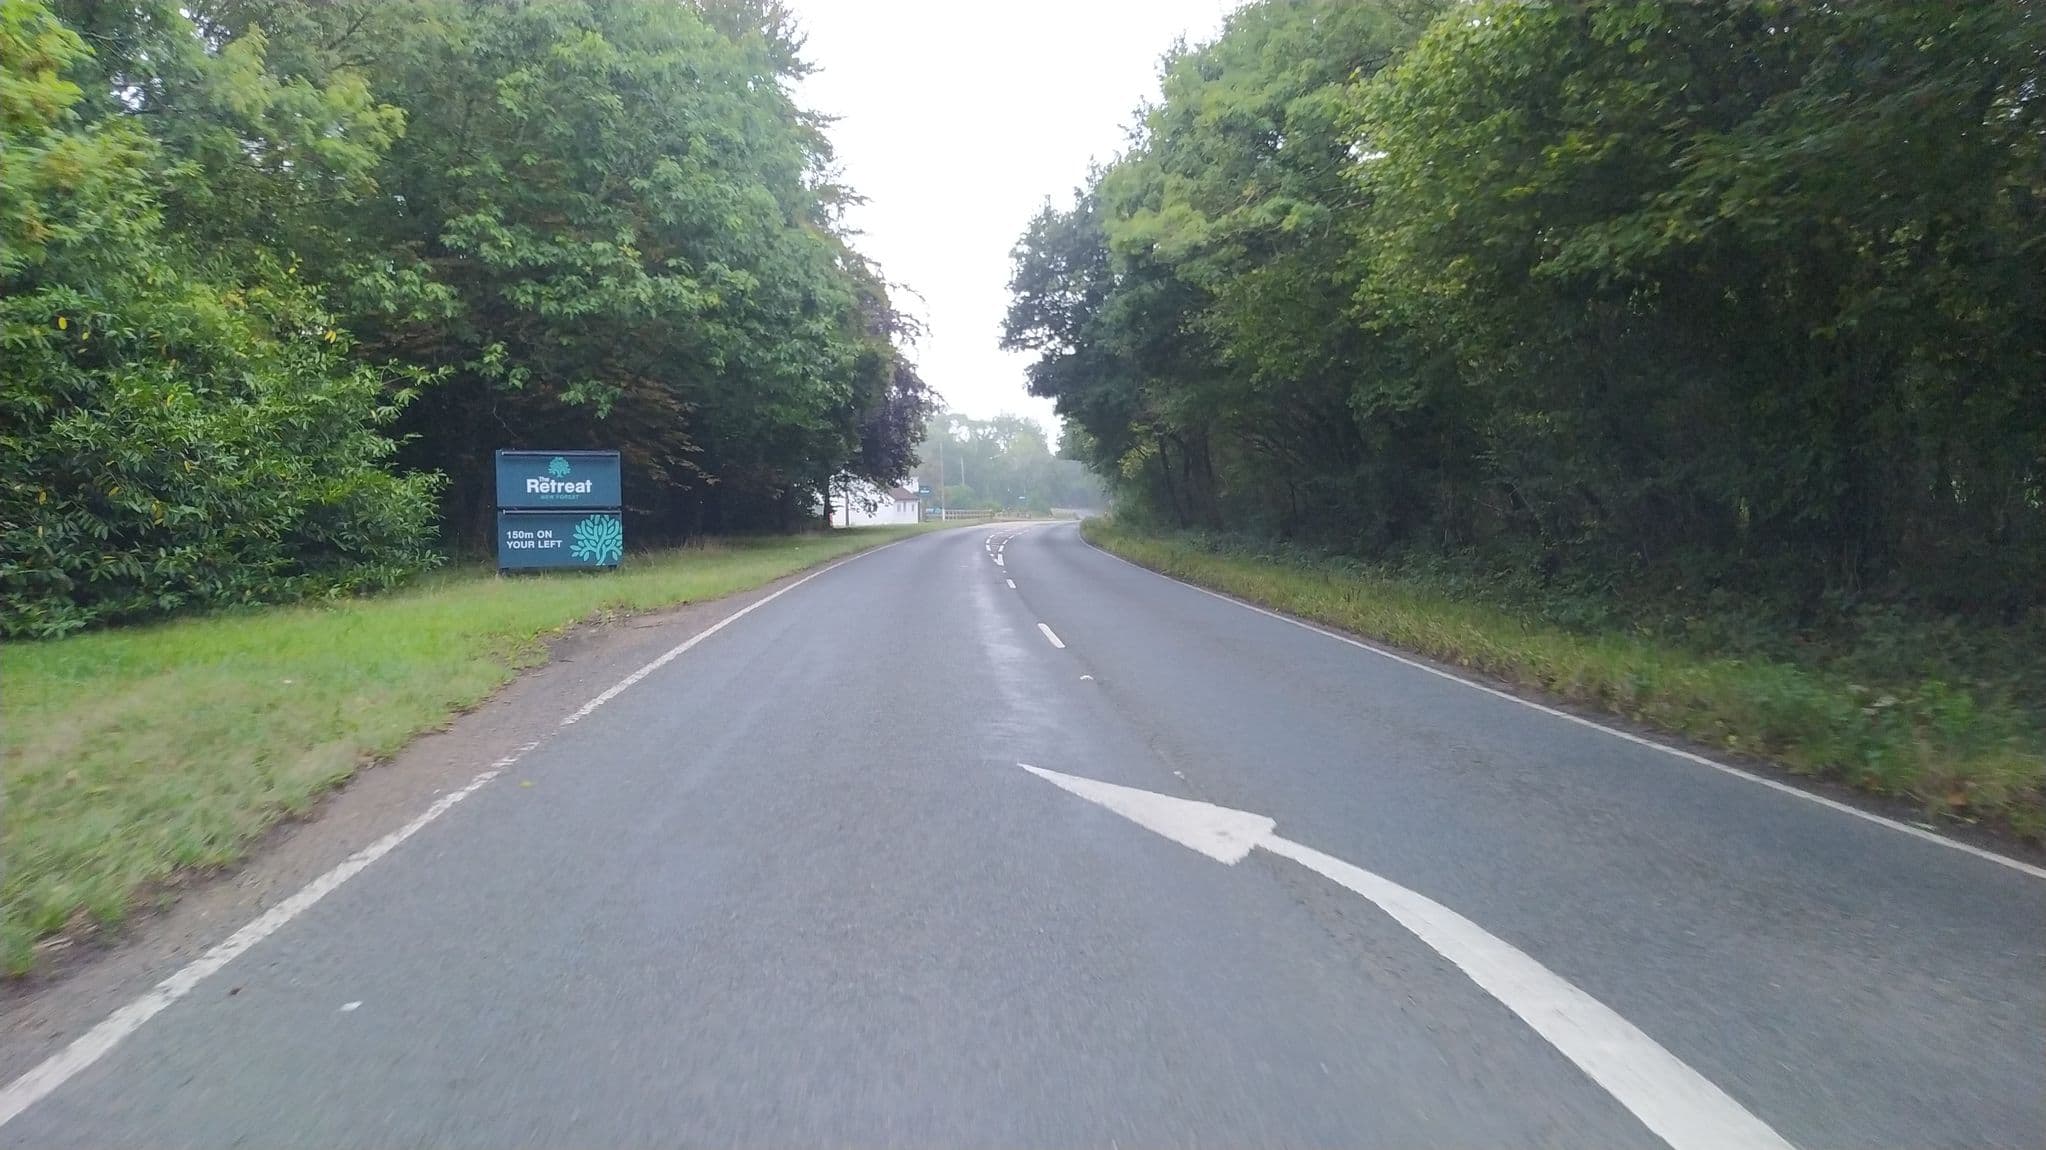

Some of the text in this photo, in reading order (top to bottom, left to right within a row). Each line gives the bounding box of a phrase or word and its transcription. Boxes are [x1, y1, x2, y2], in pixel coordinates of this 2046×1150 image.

[526, 479, 592, 493] Retreat
[506, 530, 552, 539] 150m ON
[506, 540, 562, 549] YOUR LEFT
